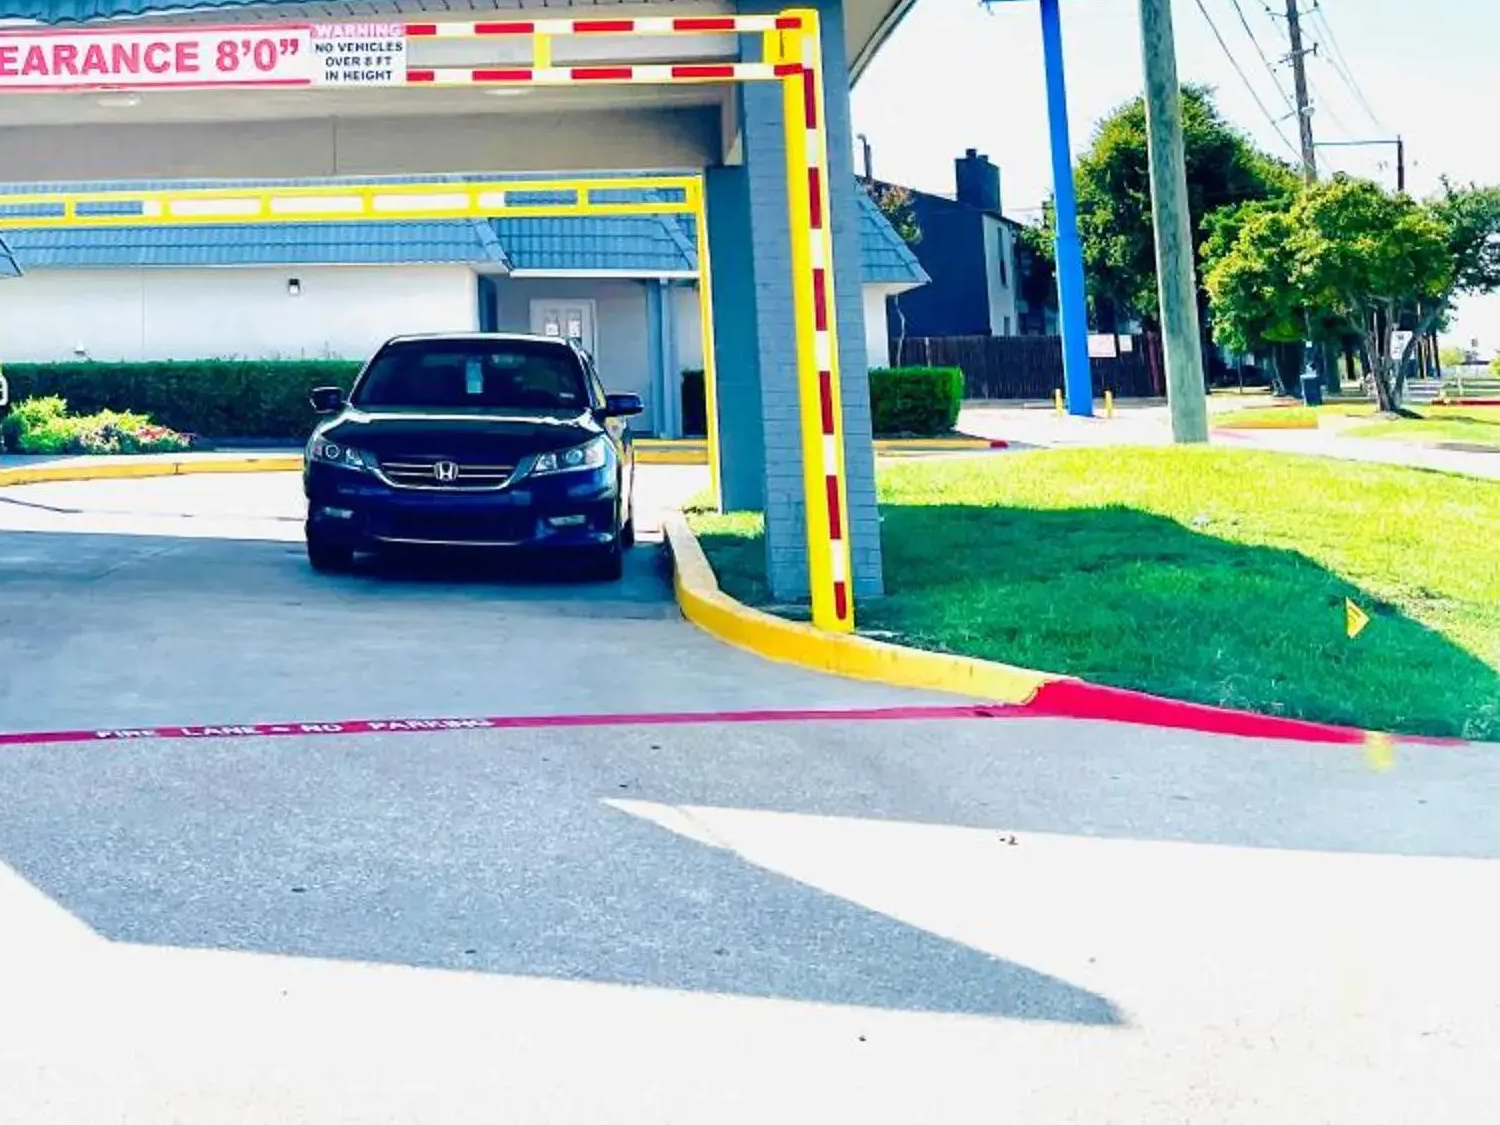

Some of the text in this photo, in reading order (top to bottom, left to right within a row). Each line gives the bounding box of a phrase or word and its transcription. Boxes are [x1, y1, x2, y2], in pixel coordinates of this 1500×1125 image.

[314, 22, 401, 37] WARNING
[315, 42, 402, 53] NO VEHICLES
[216, 38, 299, 71] 8'0"
[325, 56, 392, 67] OVER 8 FT
[325, 70, 392, 81] IN HEIGHT
[180, 726, 258, 737] LANE
[300, 722, 344, 733] NO
